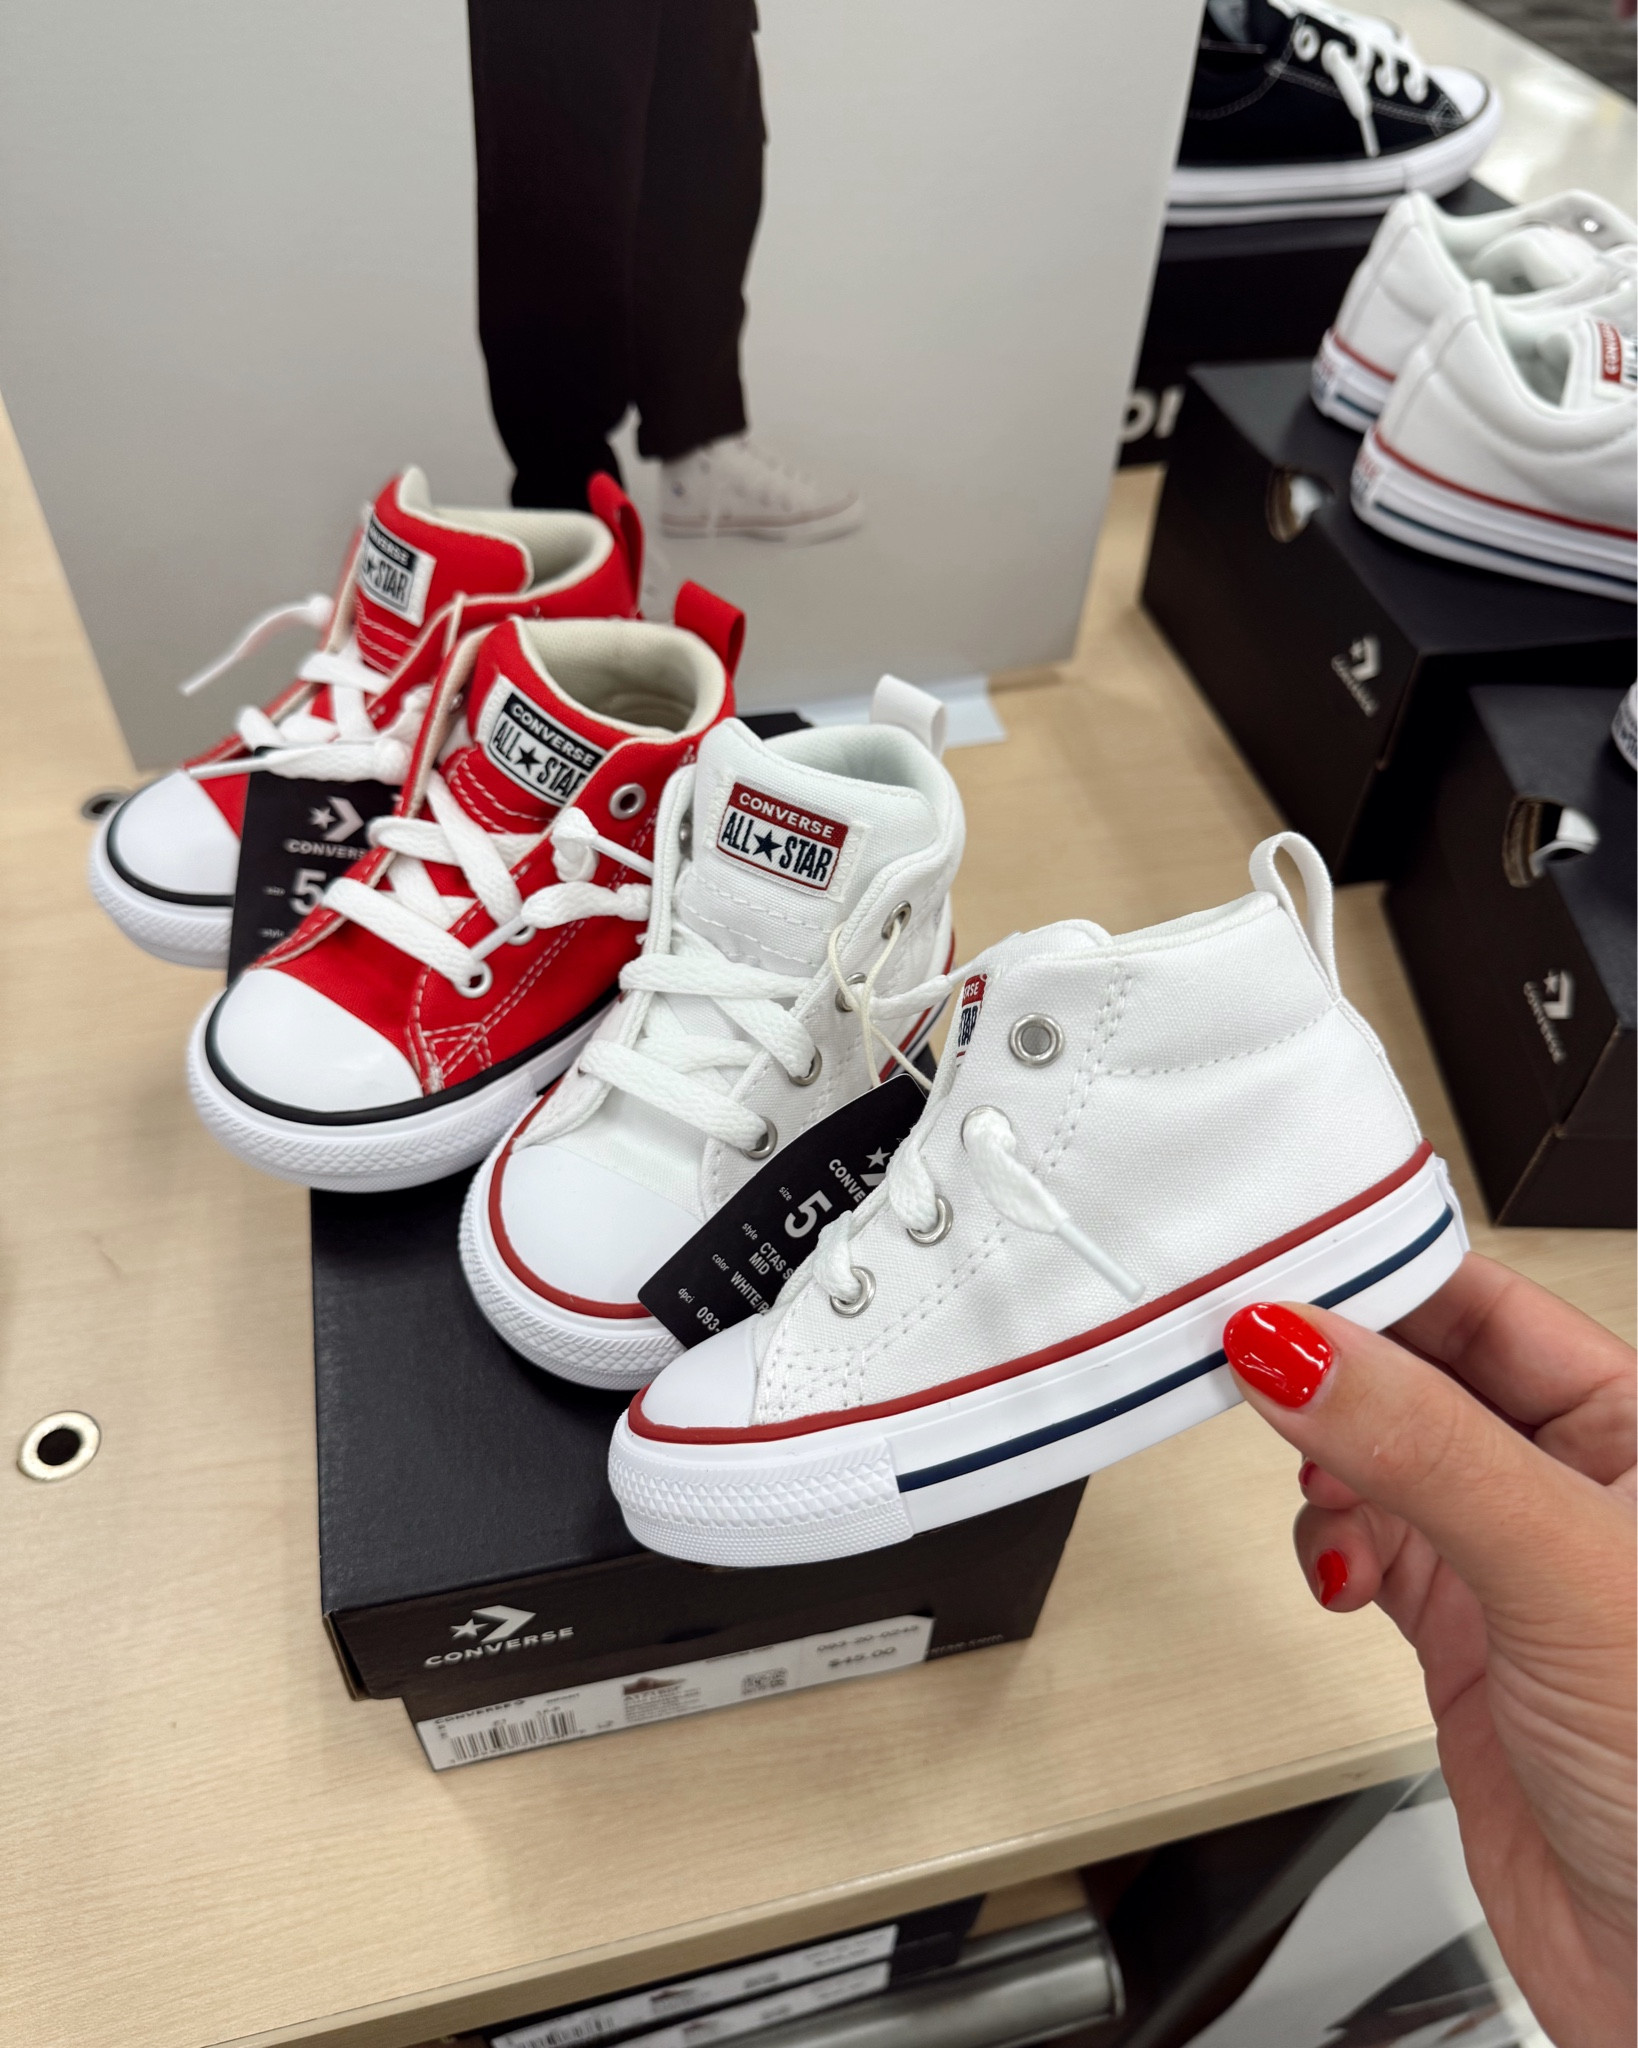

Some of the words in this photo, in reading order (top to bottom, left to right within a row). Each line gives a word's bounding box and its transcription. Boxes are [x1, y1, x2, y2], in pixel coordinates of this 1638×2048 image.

[368, 522, 411, 567] NVERSE
[374, 560, 409, 602] STAR
[492, 720, 522, 762] ALL
[509, 702, 597, 768] CONVERSE
[739, 792, 835, 839] CONVERSE
[283, 838, 368, 860] CONVERS
[721, 811, 755, 854] ALL
[778, 835, 833, 882] STAR
[289, 867, 328, 916] 5
[778, 1186, 793, 1201] size
[828, 1158, 867, 1203] CONVE
[784, 1189, 834, 1239] 5
[741, 1222, 759, 1241] style
[759, 1242, 787, 1272] CTAS
[748, 1251, 771, 1276] MID
[711, 1253, 730, 1272] color
[729, 1270, 771, 1316] WHITE/R
[677, 1287, 696, 1304] dpci
[695, 1305, 727, 1333] 093-
[424, 1626, 576, 1668] CONVERSE
